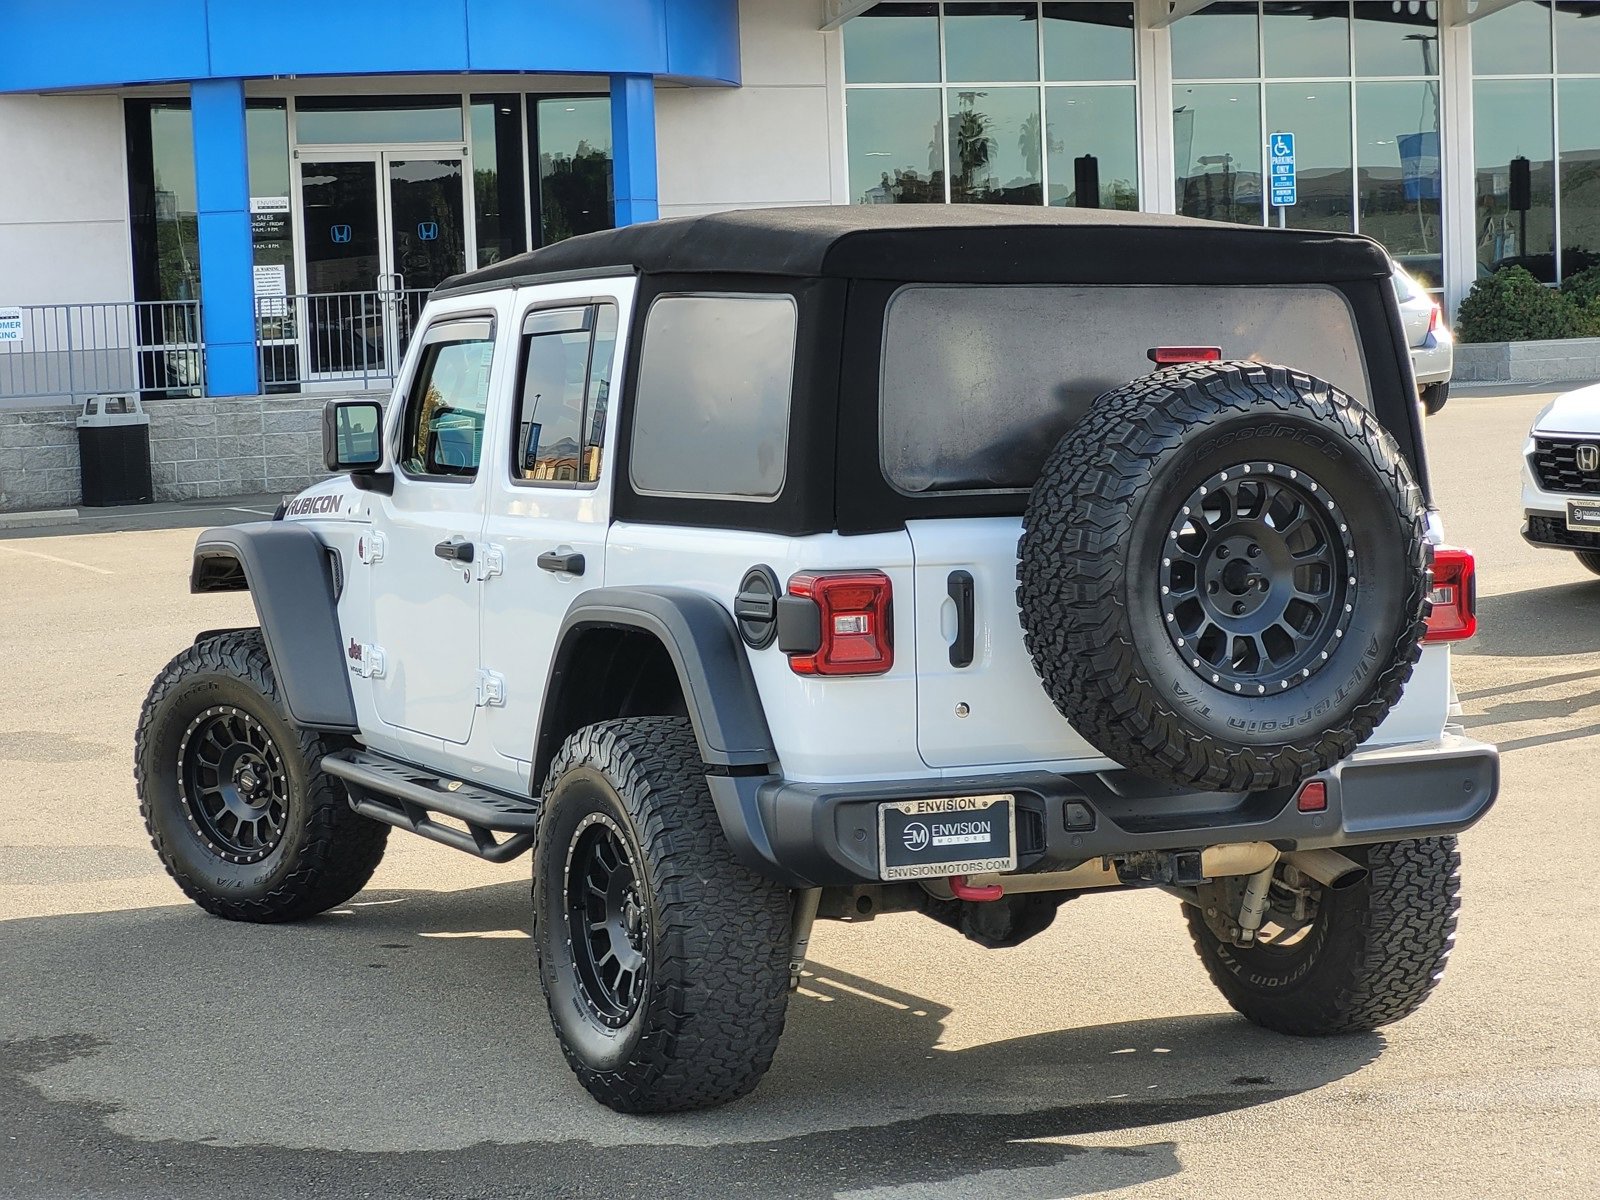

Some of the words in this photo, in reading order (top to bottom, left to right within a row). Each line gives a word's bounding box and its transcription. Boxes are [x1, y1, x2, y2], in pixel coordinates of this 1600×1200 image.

[1276, 165, 1289, 173] ONLY
[286, 494, 344, 516] RUBICON
[1171, 677, 1216, 721] T/A
[917, 798, 977, 813] ENVISION
[931, 820, 991, 837] ENVISION
[937, 835, 986, 844] MOTORS
[887, 859, 1011, 879] ENVISIONMOTORS.COM
[1216, 943, 1243, 977] T/A
